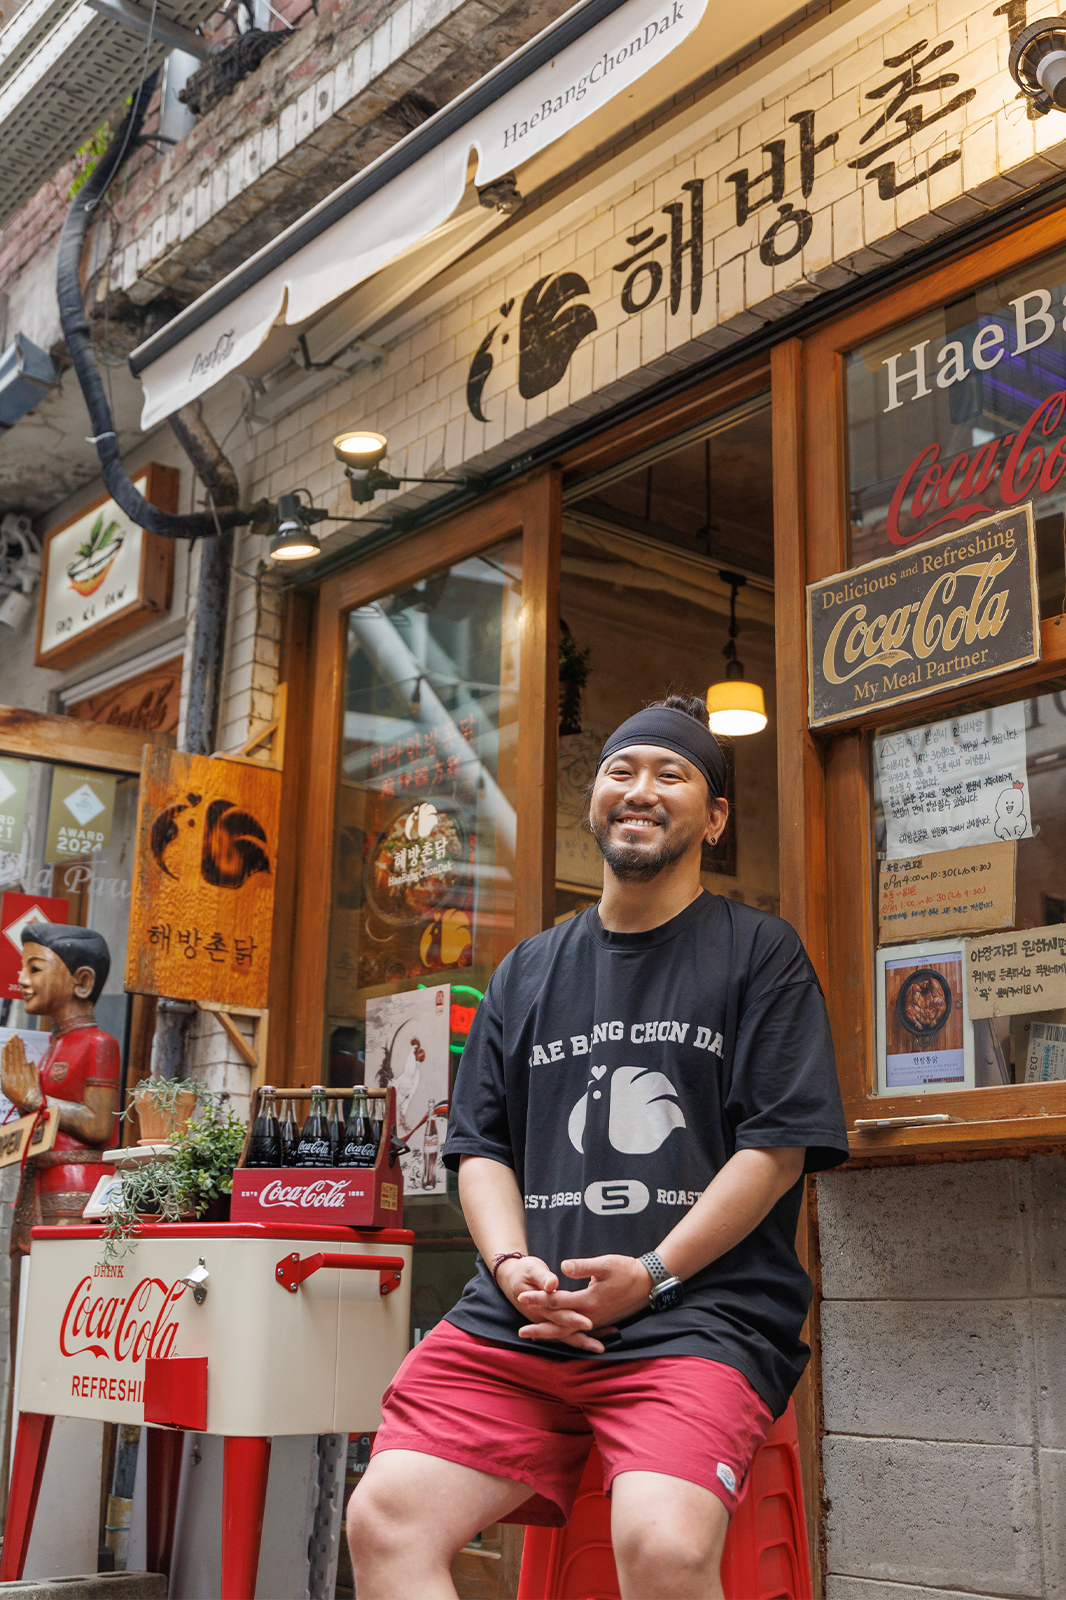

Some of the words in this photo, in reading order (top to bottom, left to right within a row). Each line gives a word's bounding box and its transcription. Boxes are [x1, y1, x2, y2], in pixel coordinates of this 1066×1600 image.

[502, 1, 684, 150] HaeBangChonDak
[881, 288, 1066, 413] HaeB
[821, 570, 897, 610] Delicious
[900, 564, 918, 579] and
[921, 527, 1016, 575] Refreshing
[822, 548, 1018, 685] Coca-Cola
[853, 682, 879, 701] My
[882, 665, 922, 693] Meal
[926, 649, 989, 679] Partner
[924, 727, 947, 746] 발생시
[952, 718, 984, 738] 안내사항
[56, 836, 103, 854] 2024
[58, 826, 105, 842] AWARD
[394, 836, 449, 869] 해방촌닭
[388, 860, 454, 887] HaeBangChonDak
[147, 923, 258, 966] 해방촌닭
[970, 942, 1018, 962] 야장자리
[528, 1039, 566, 1068] AE
[569, 1020, 625, 1057] BNG
[630, 1020, 690, 1044] CHON
[259, 1179, 352, 1208] Coca-Cola
[93, 1264, 124, 1278] DRINK
[59, 1275, 188, 1364] Coca-Cola
